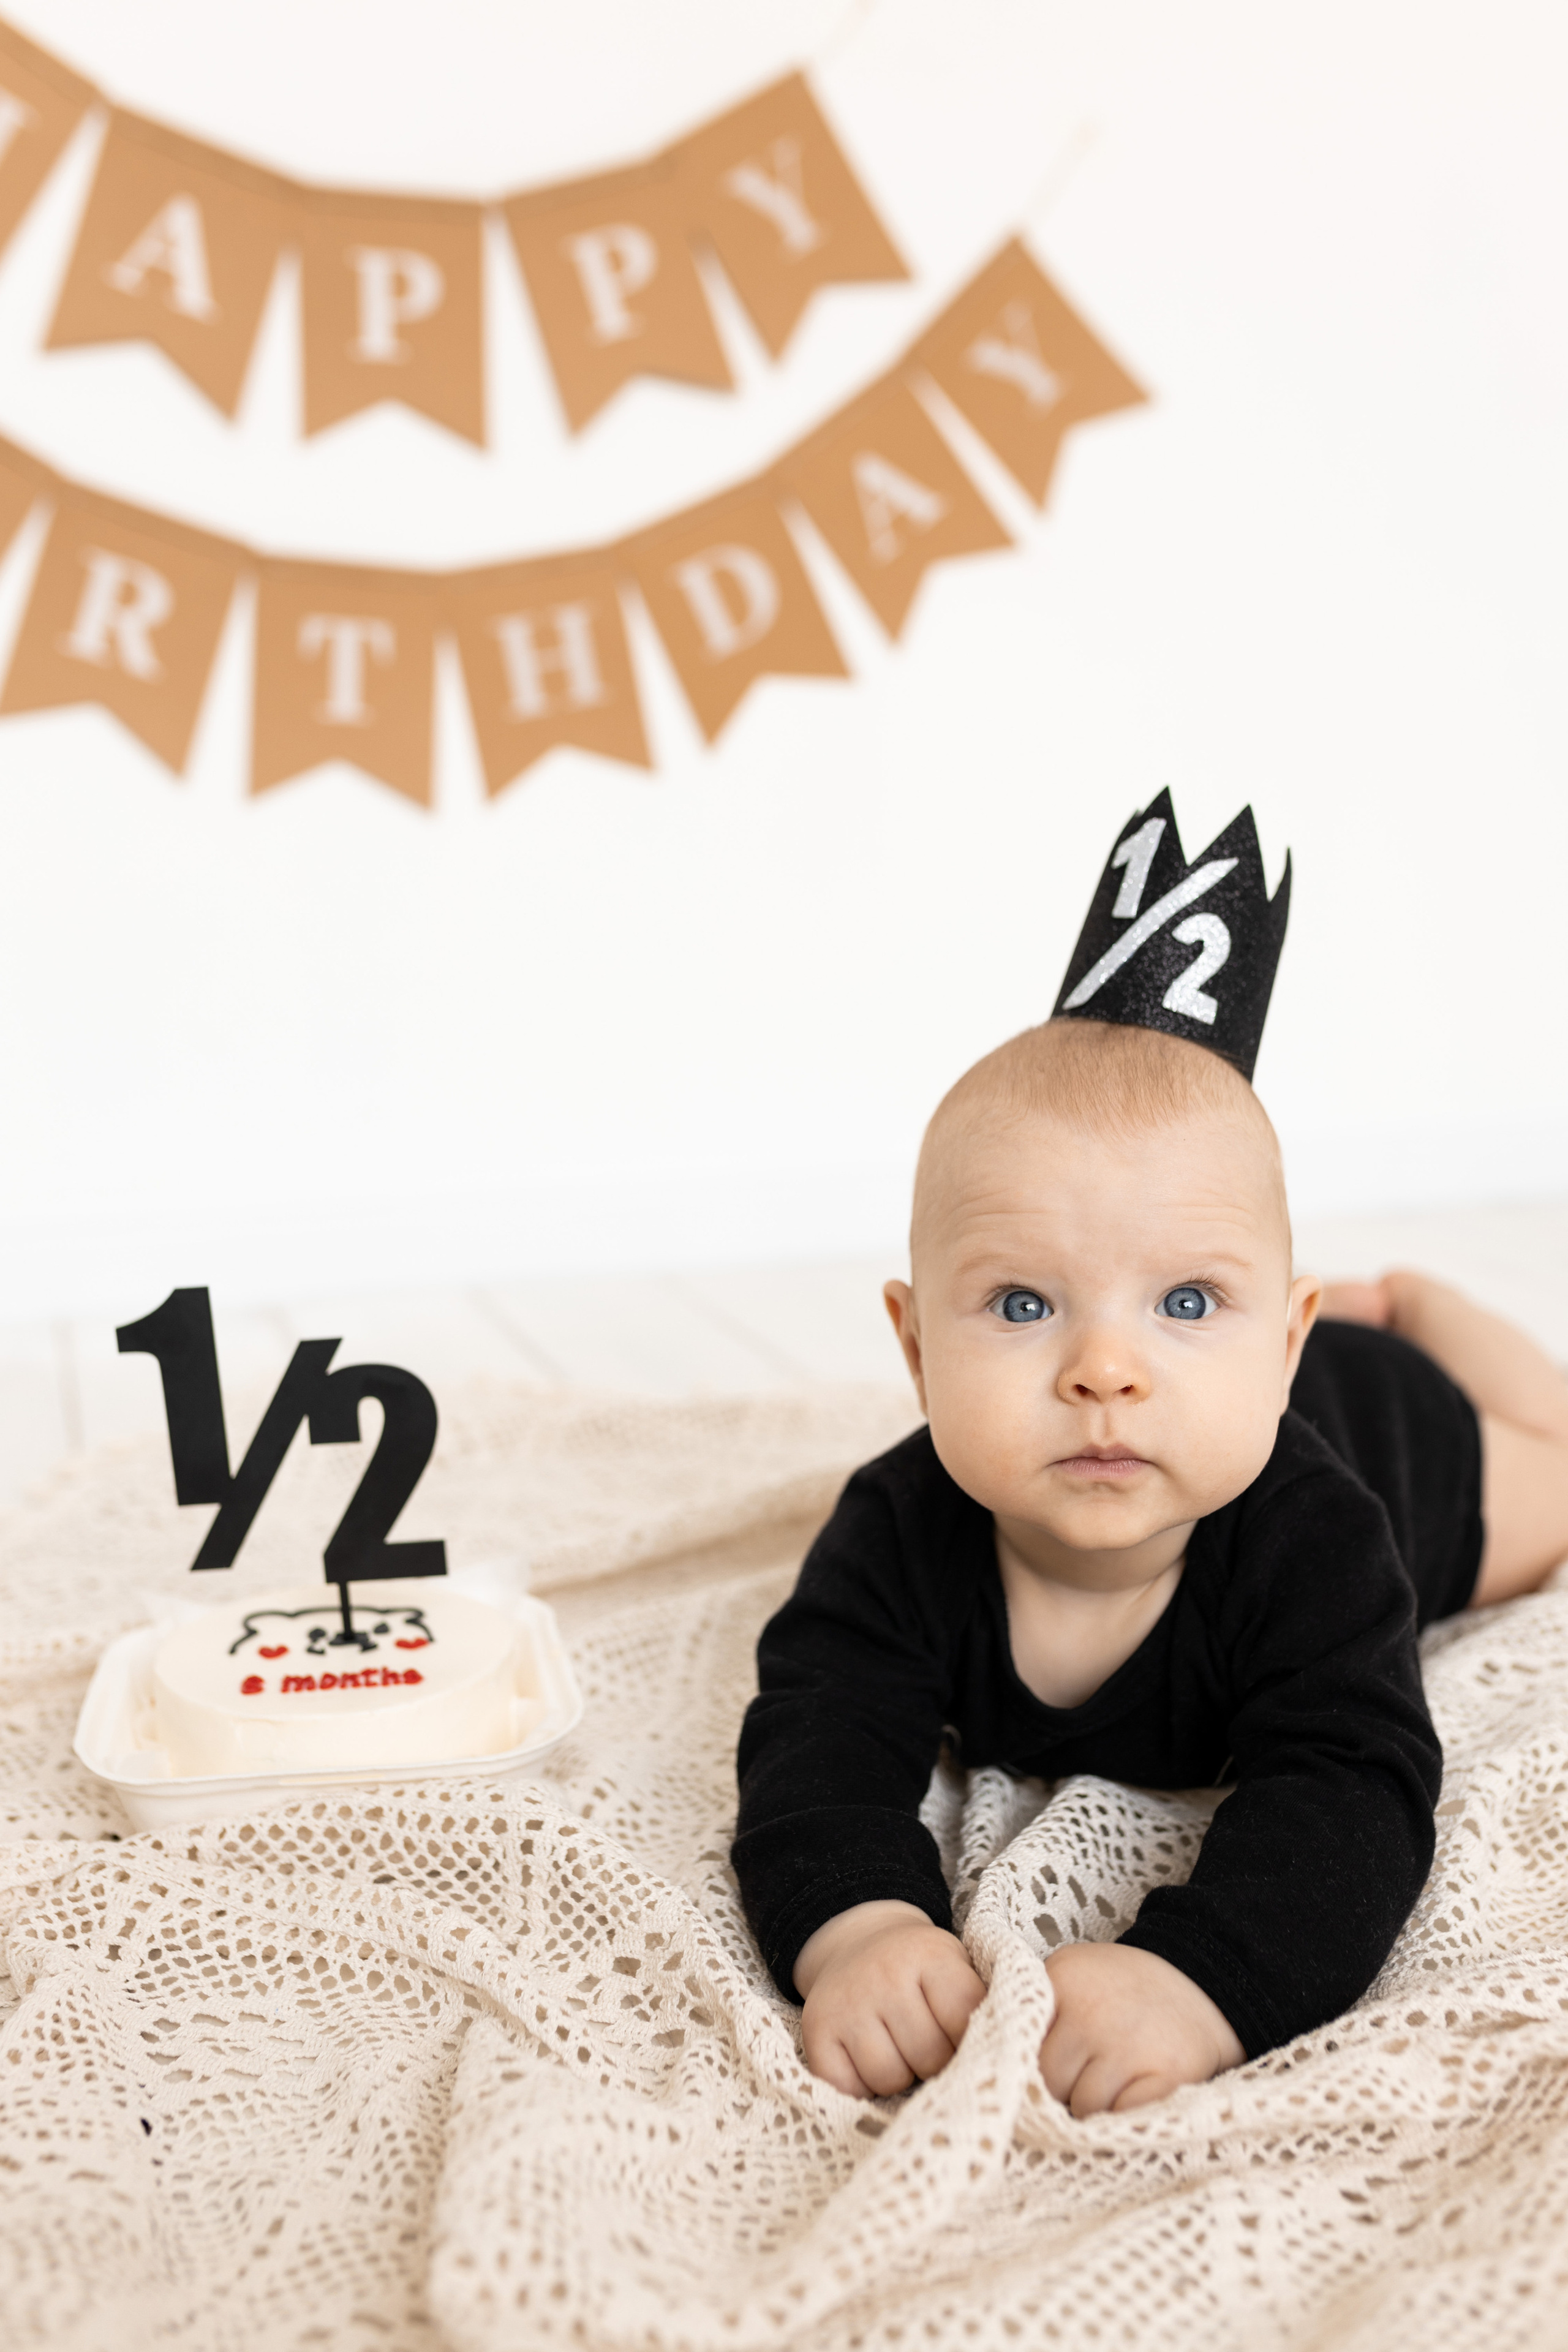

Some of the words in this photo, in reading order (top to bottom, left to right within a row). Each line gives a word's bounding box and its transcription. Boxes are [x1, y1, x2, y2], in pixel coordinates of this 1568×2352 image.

[0, 89, 812, 366] APPY
[1062, 816, 1240, 1026] 1/2
[116, 1285, 448, 1583] 1/2
[281, 1666, 424, 1693] months
